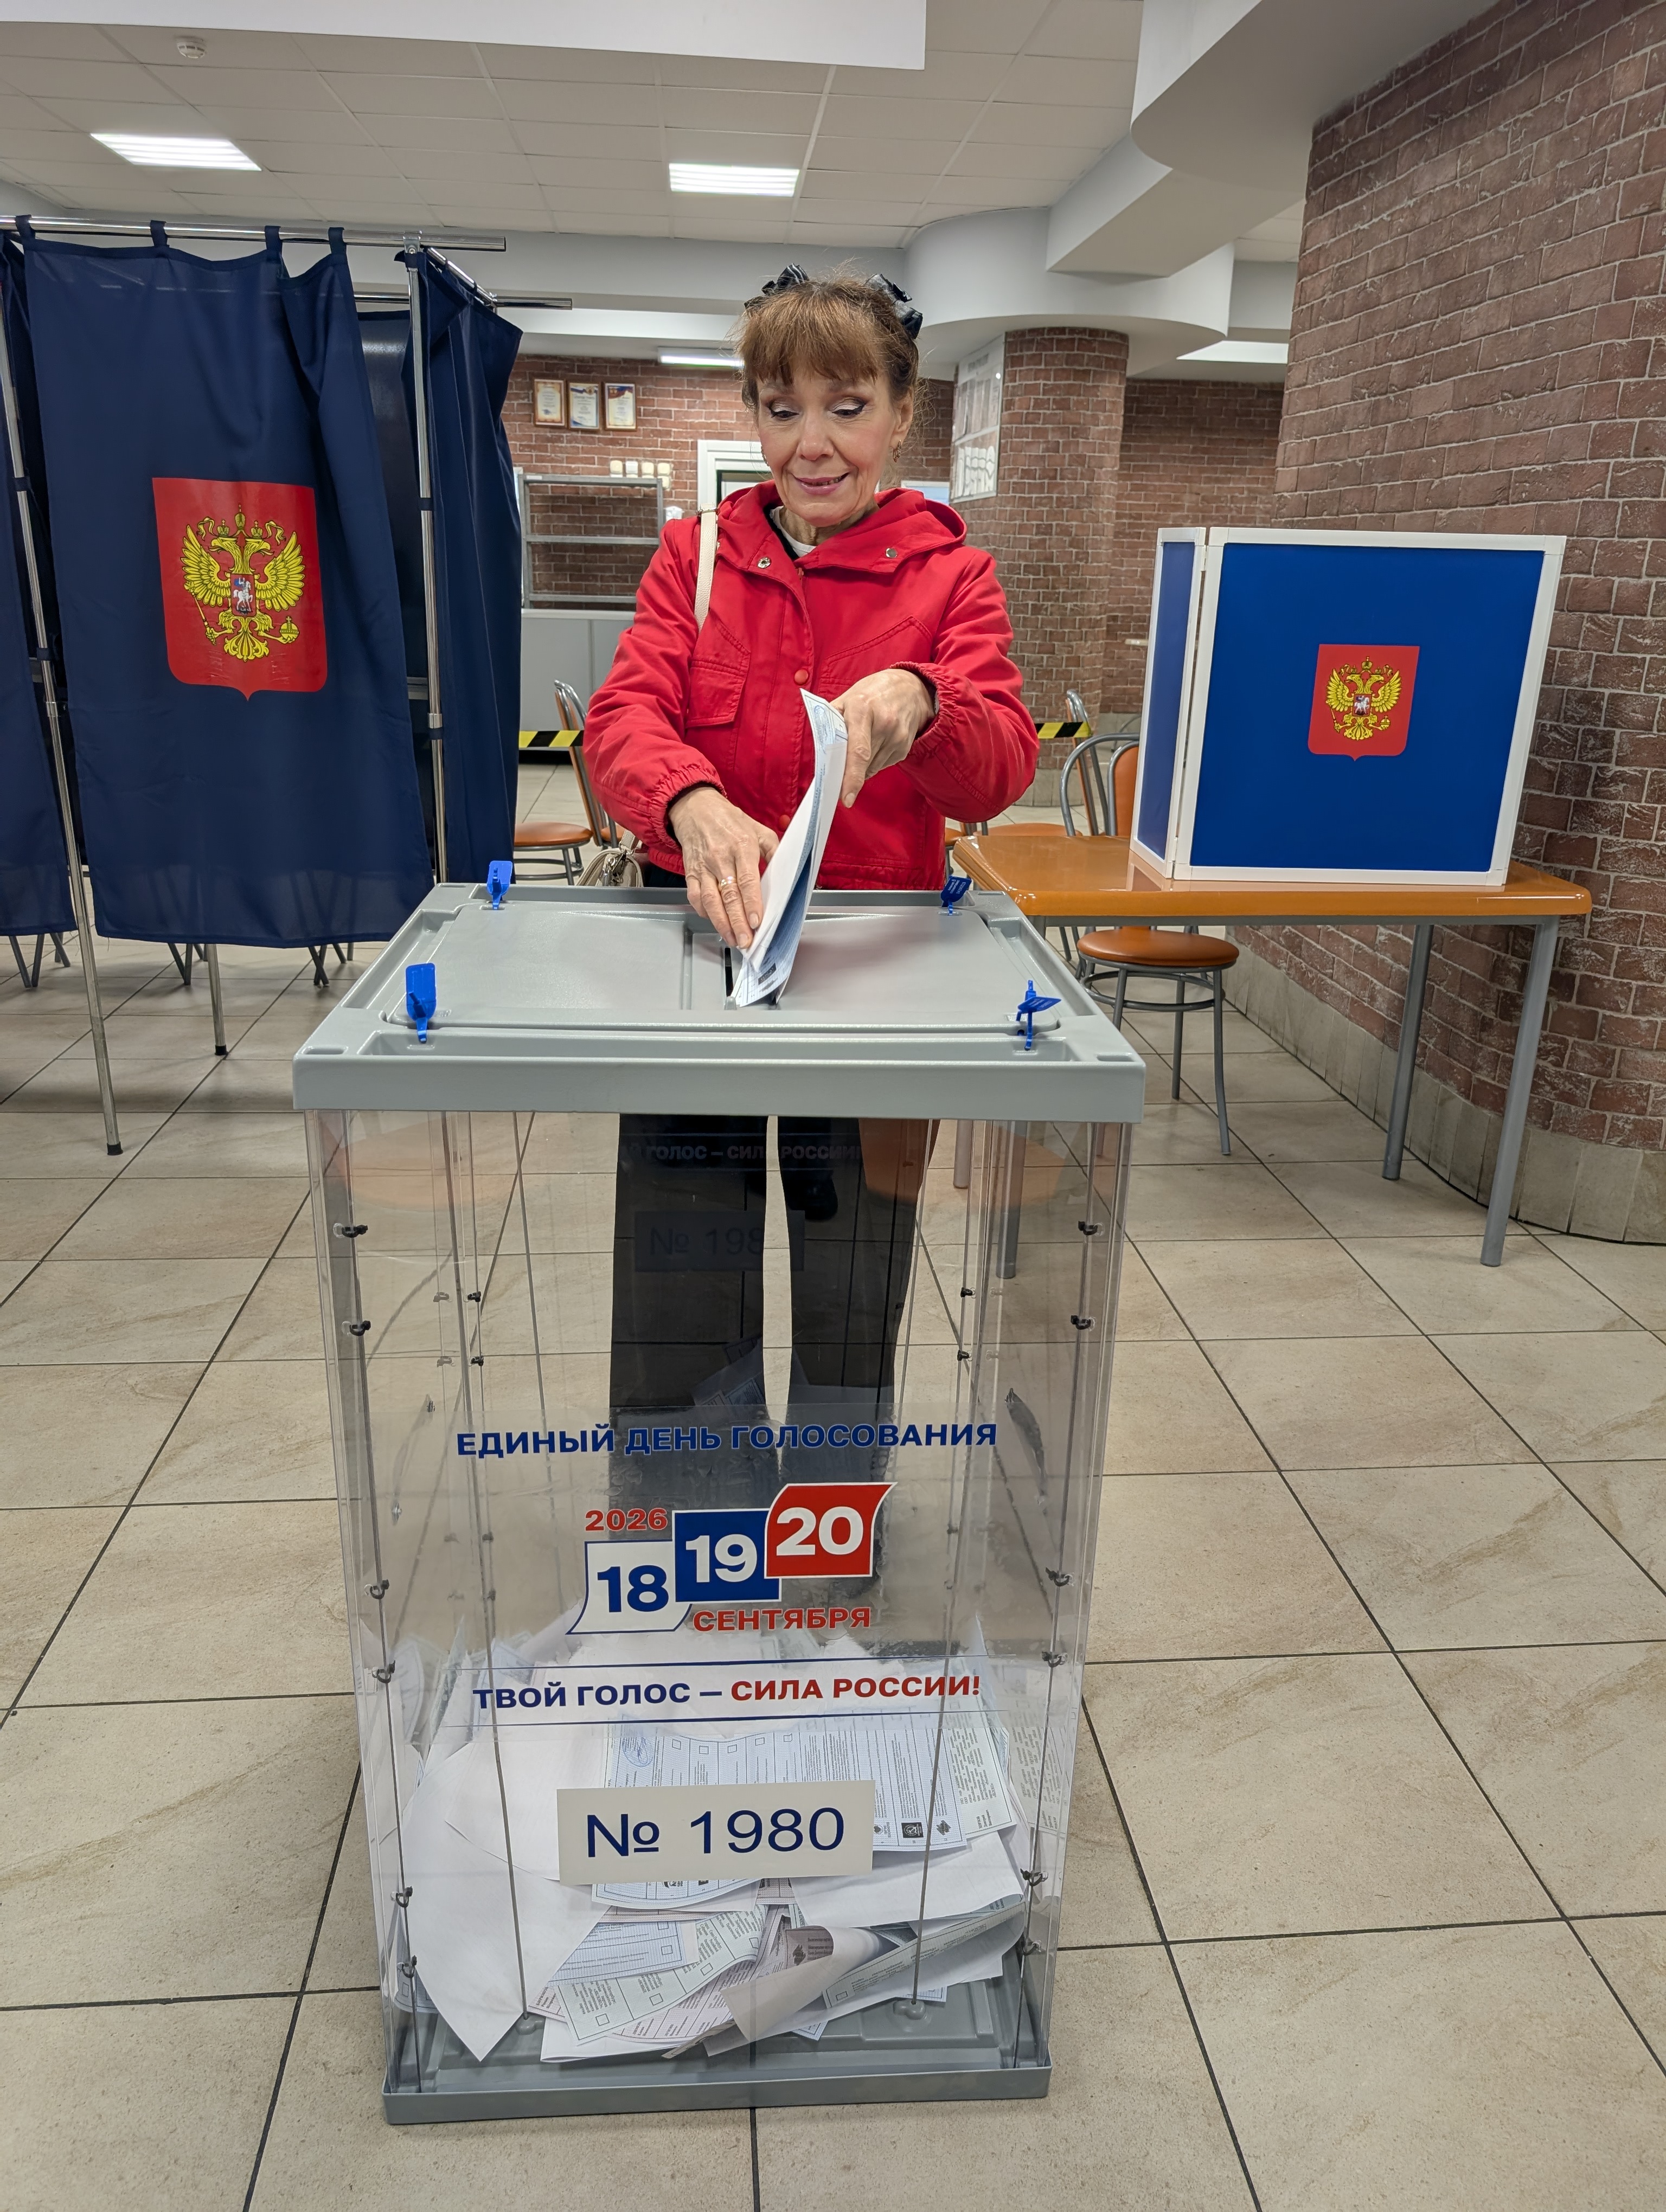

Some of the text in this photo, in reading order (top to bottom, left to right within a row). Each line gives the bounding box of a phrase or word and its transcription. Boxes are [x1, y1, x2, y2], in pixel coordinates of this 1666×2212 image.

[457, 1423, 998, 1458] ЕДИНЫЙ ДЕНЬ ГОЛОСОВАНИЯ
[585, 1507, 668, 1532] 2026
[776, 1506, 864, 1556] 20
[685, 1533, 758, 1583] 19
[597, 1564, 670, 1613] 18
[693, 1606, 872, 1633] СЕНТЯБРЯ
[472, 1681, 566, 1709] ТВОЙ
[576, 1683, 690, 1708] ГОЛОС
[730, 1679, 823, 1702] СИЛА
[833, 1675, 981, 1699] РОССИИ!
[587, 1807, 846, 1857] № 1980
